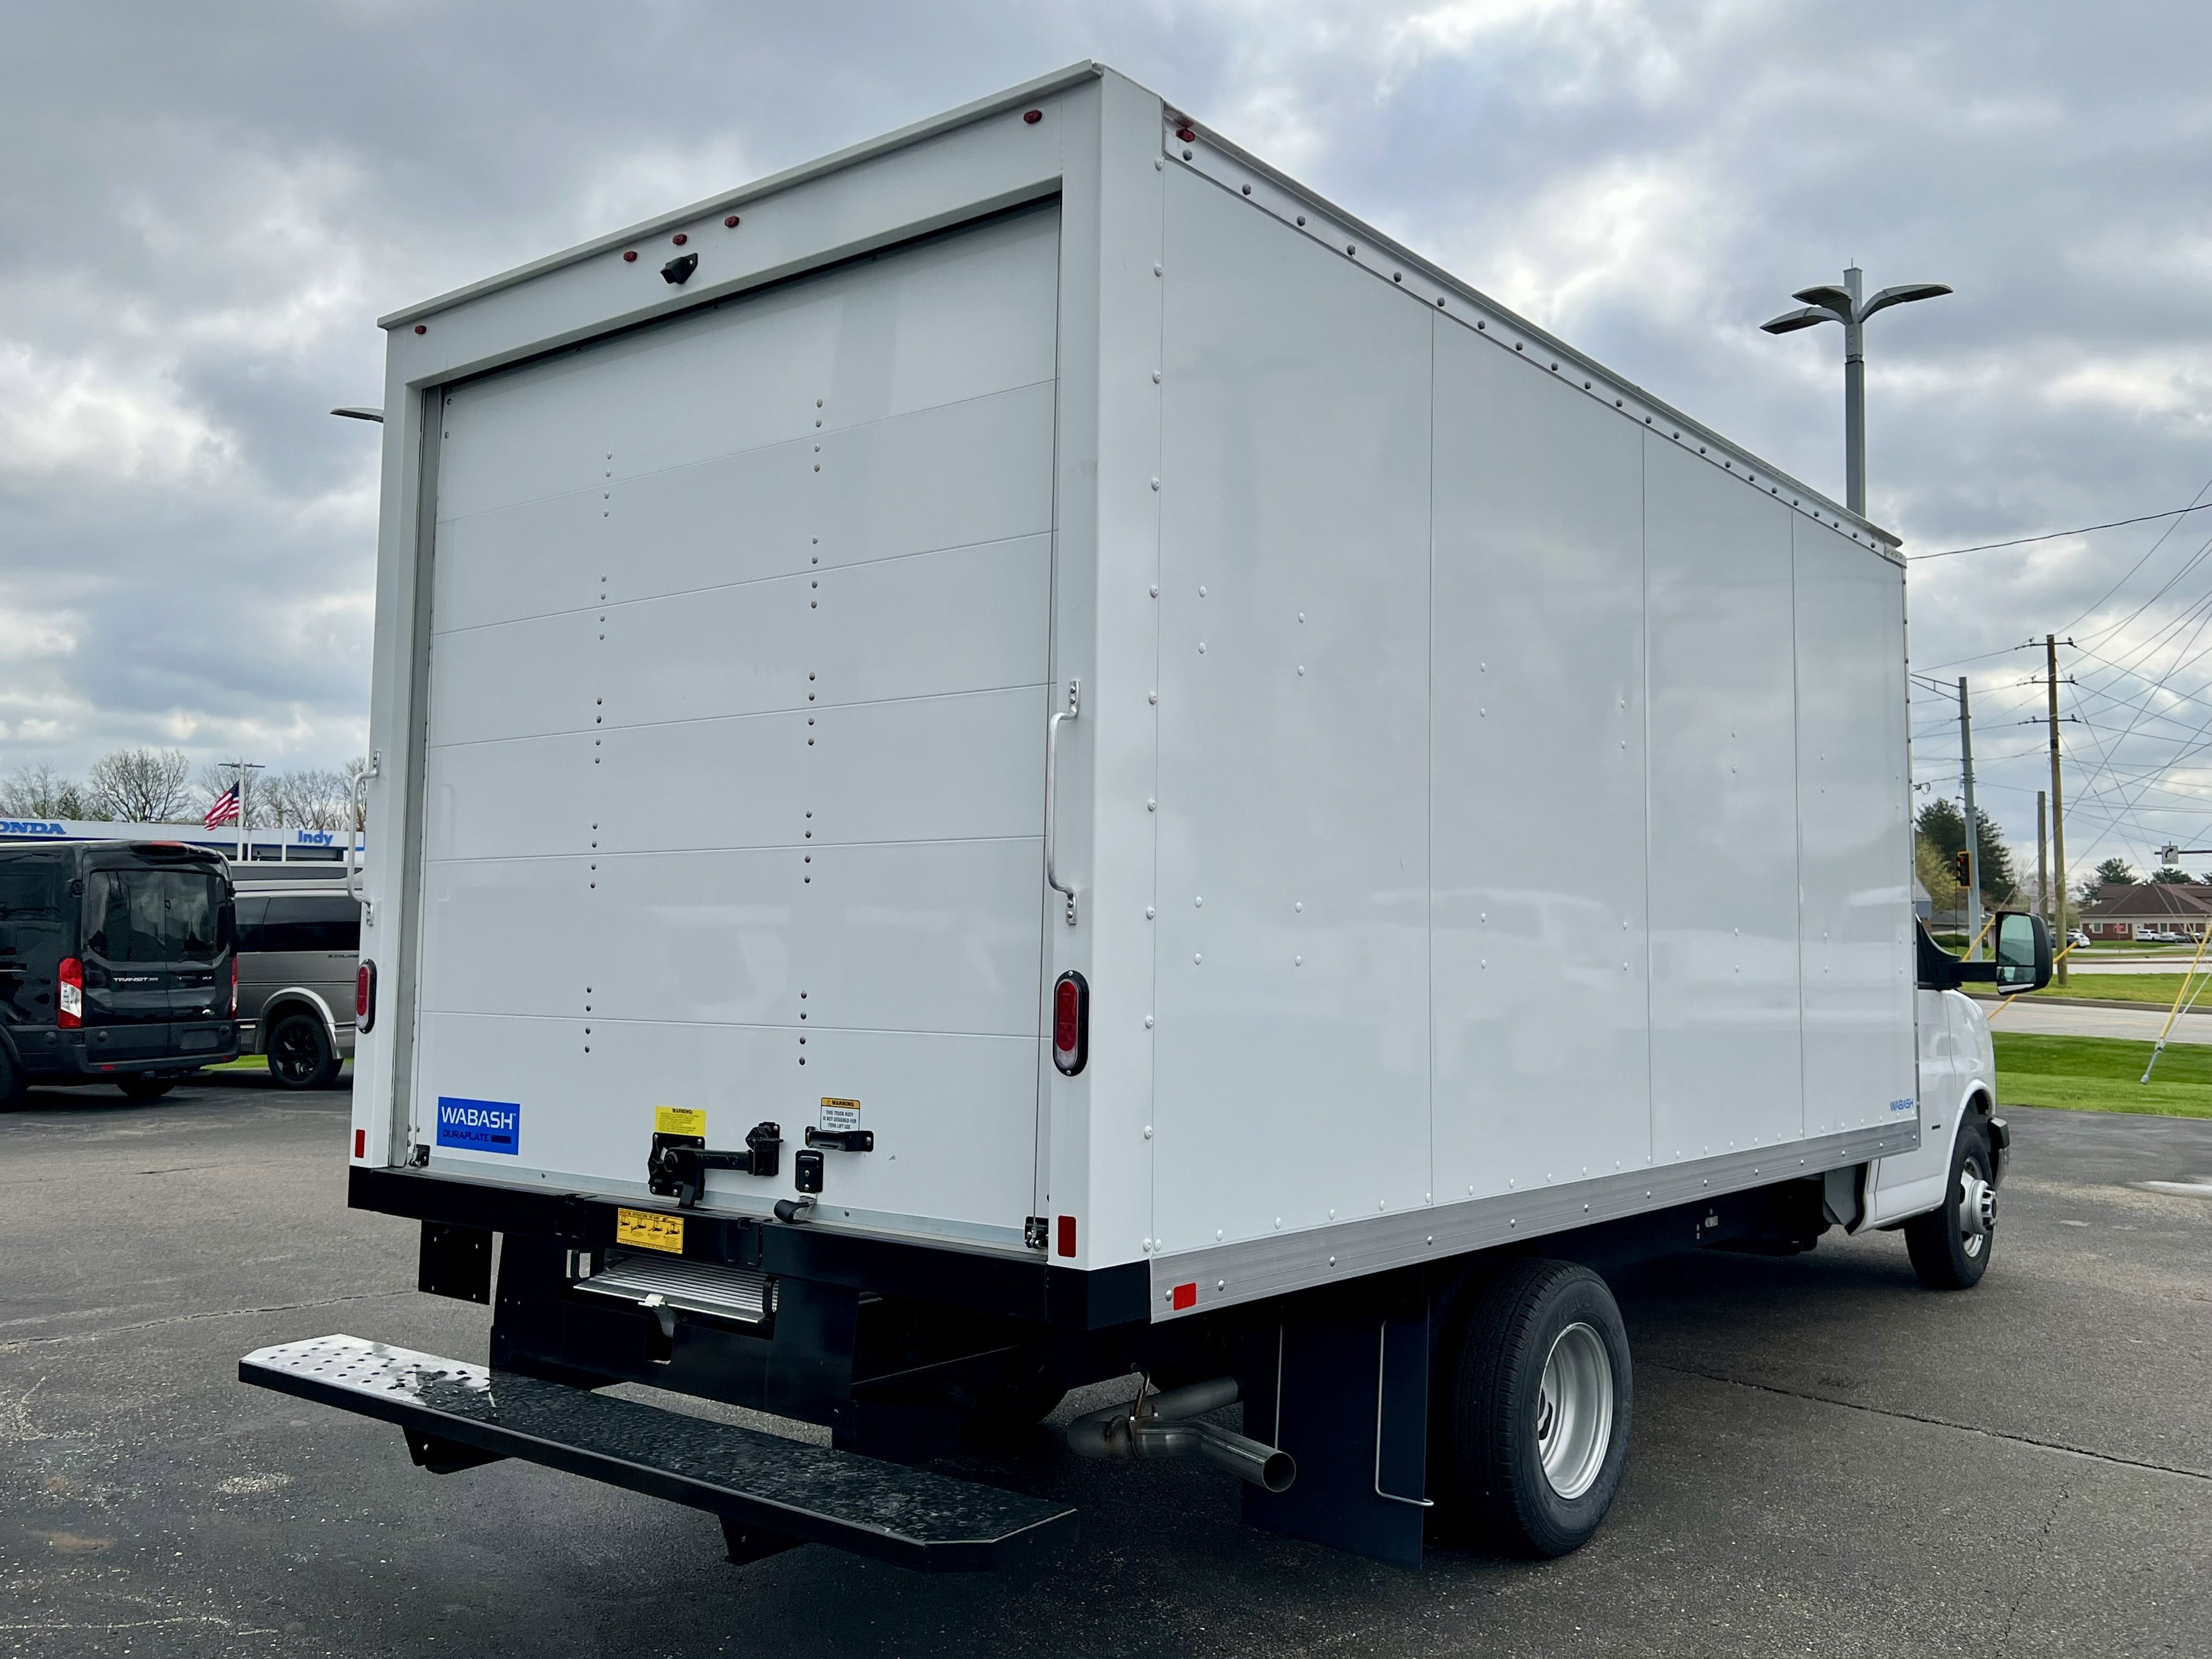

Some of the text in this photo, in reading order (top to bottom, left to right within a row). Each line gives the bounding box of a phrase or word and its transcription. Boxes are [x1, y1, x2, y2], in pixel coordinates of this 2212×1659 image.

[298, 829, 333, 847] Indy
[1890, 1098, 1914, 1111] WABASH
[441, 1106, 513, 1130] WABASH
[443, 1129, 490, 1142] DURAPLATE
